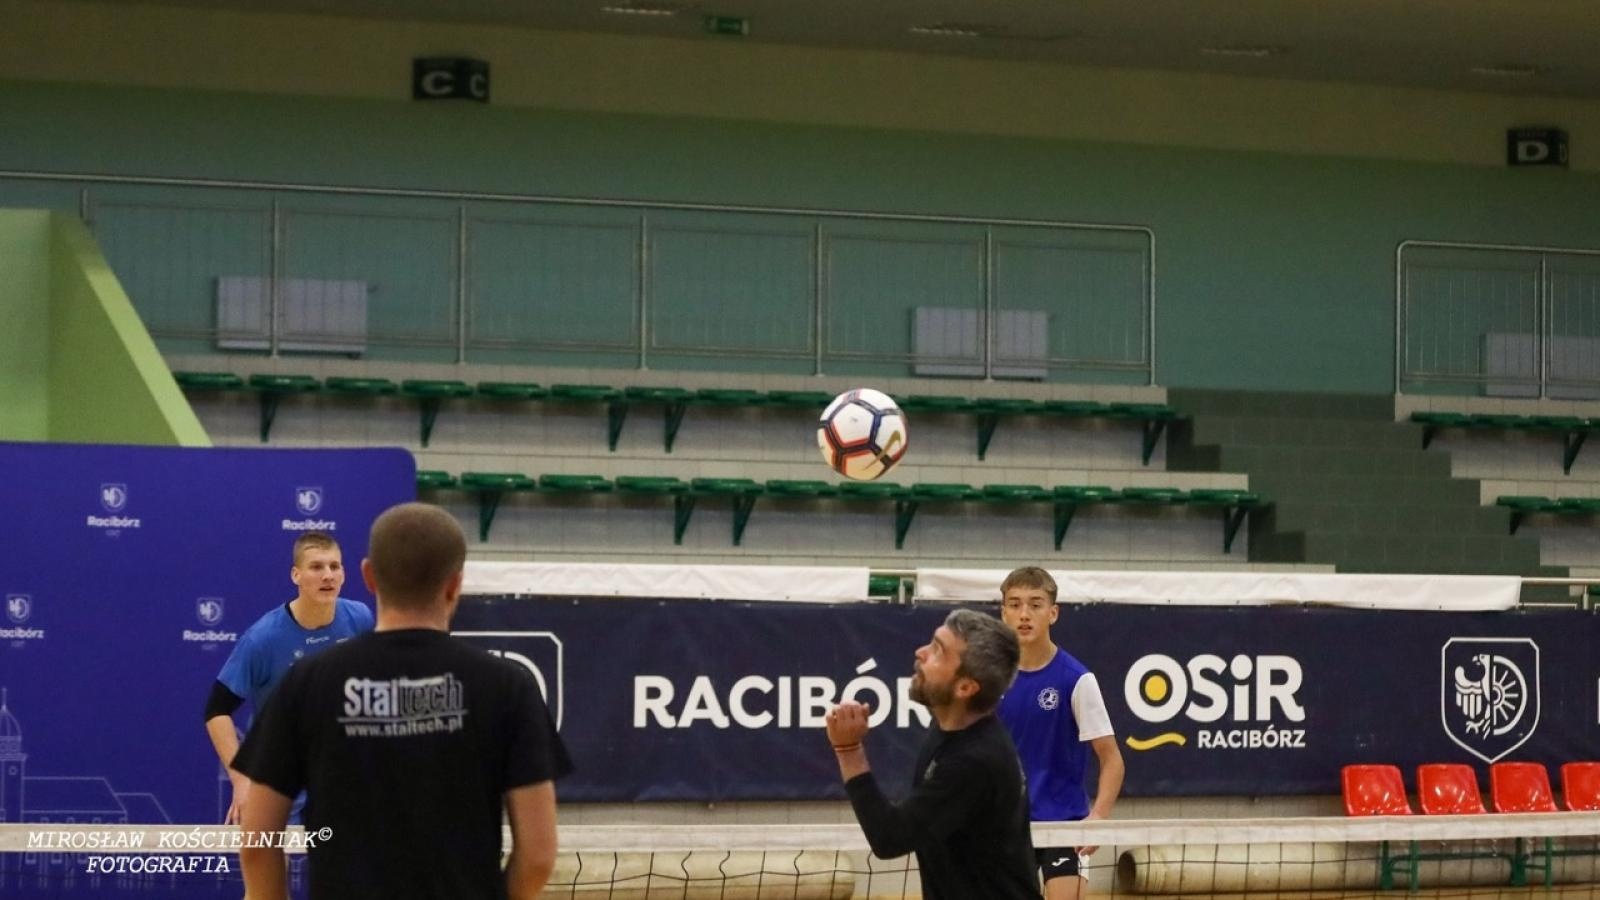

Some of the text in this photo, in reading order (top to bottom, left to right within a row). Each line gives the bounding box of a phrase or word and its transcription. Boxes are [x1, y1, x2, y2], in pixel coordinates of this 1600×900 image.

[422, 71, 454, 95] C
[1517, 141, 1549, 162] D
[87, 515, 141, 528] Racibórz
[282, 518, 336, 531] Racibórz
[0, 627, 45, 639] acibórz
[182, 629, 237, 642] Racibórz
[633, 657, 932, 728] RACIBÓR
[1124, 654, 1306, 722] OSiR
[345, 714, 463, 737] www.staltech.pl
[1198, 725, 1306, 748] RACIBÓRZ
